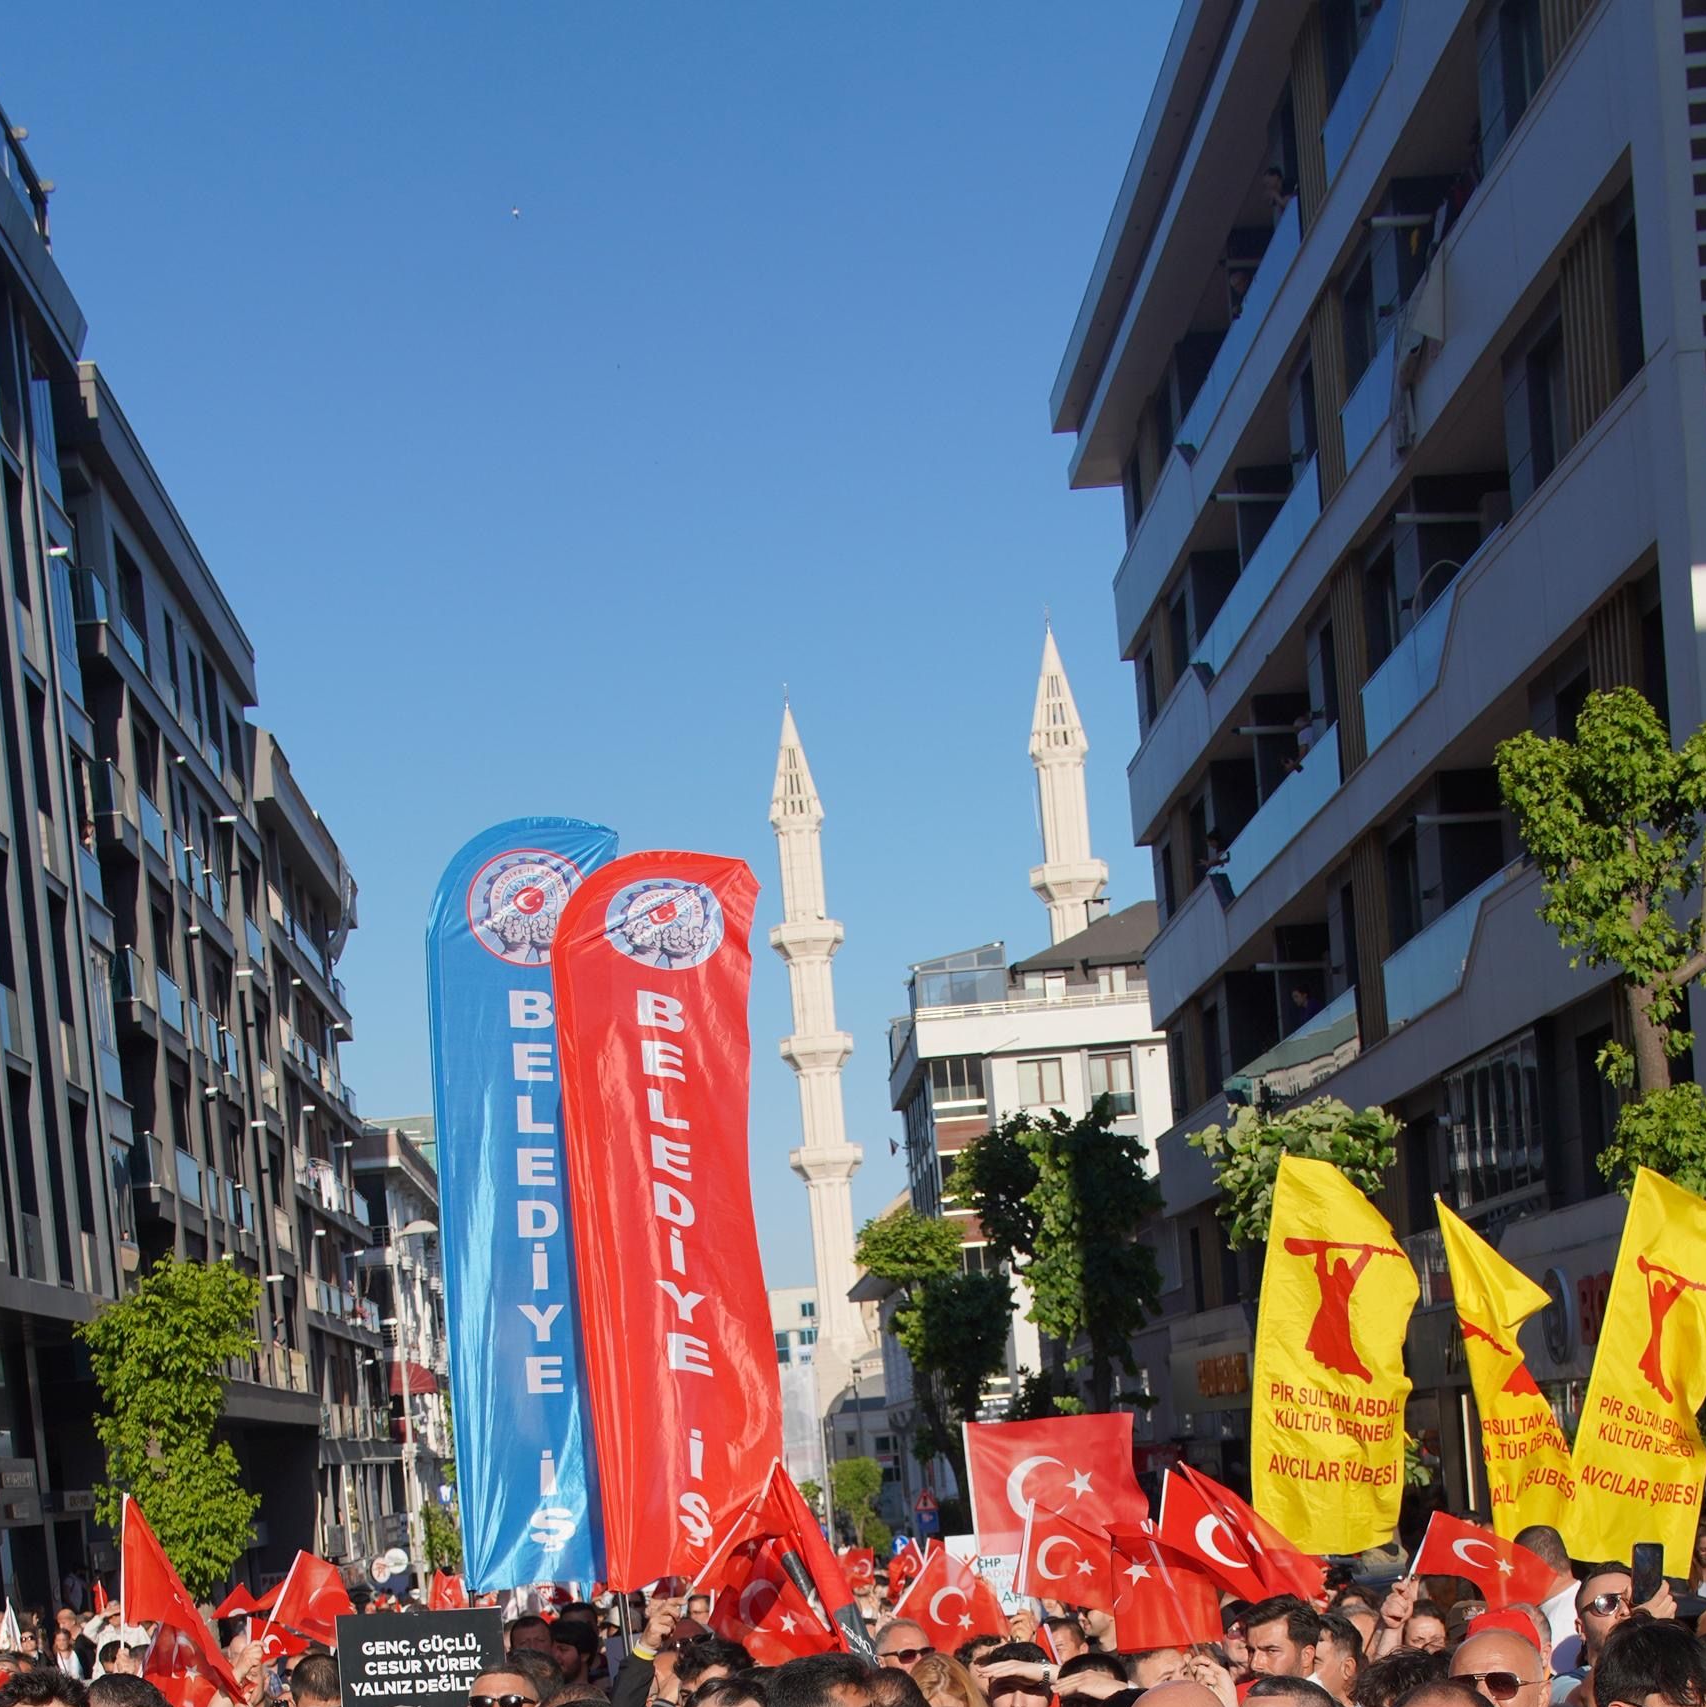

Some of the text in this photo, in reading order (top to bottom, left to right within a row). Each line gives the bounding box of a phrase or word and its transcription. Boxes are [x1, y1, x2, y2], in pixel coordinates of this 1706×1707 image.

[508, 990, 576, 1553] BELEDİYE İŞ
[637, 990, 714, 1547] BELEDİYE İŞ
[1271, 1381, 1400, 1418] PİR SULTAN ABDAL
[1599, 1395, 1623, 1418] PİR
[1275, 1408, 1332, 1433] KÜLTÜR
[1598, 1422, 1653, 1452] KÜLTÜR
[1581, 1465, 1699, 1507] AVCILAR ŞUBESİ
[361, 1633, 482, 1657] GENÇ, GÜÇLÜ,
[365, 1655, 483, 1676] CESUR YÜREK
[351, 1674, 475, 1697] YALNIZ DEĞİLD
